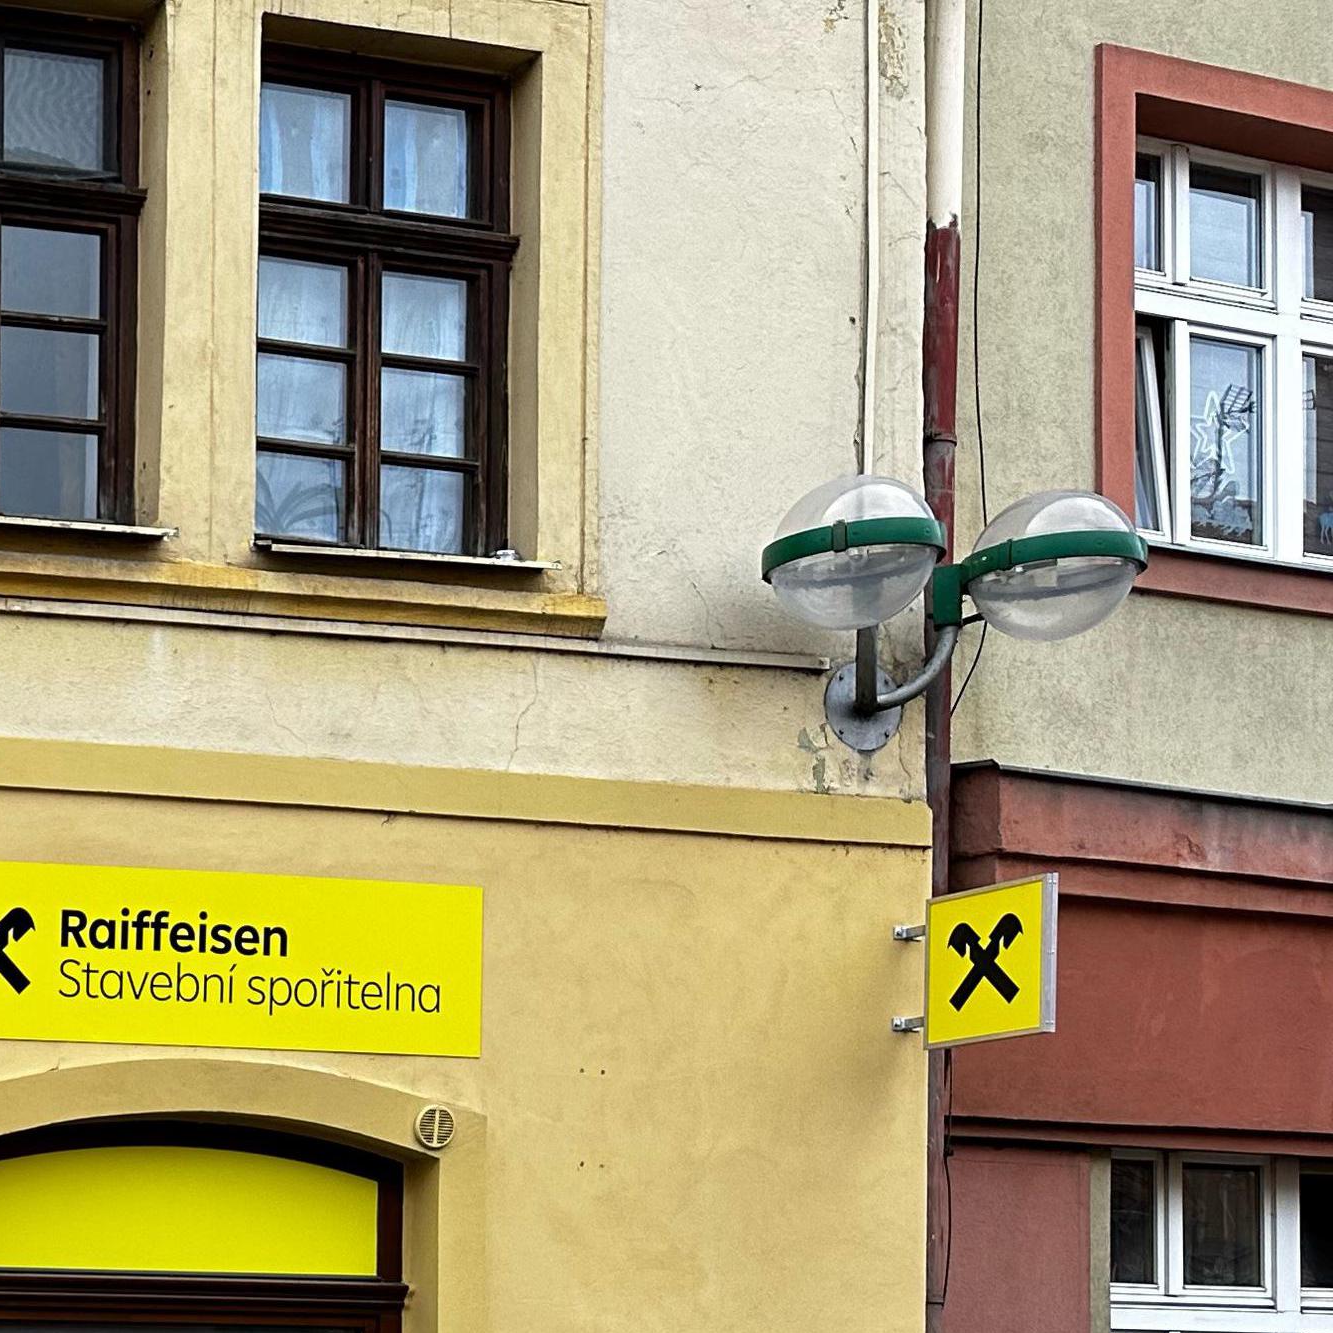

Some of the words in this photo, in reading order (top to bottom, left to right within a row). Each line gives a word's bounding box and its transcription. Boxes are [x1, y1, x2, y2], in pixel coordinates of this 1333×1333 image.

[59, 907, 288, 957] Raiffeisen
[58, 958, 237, 1004] Stavební
[247, 967, 441, 1016] spořitelna
